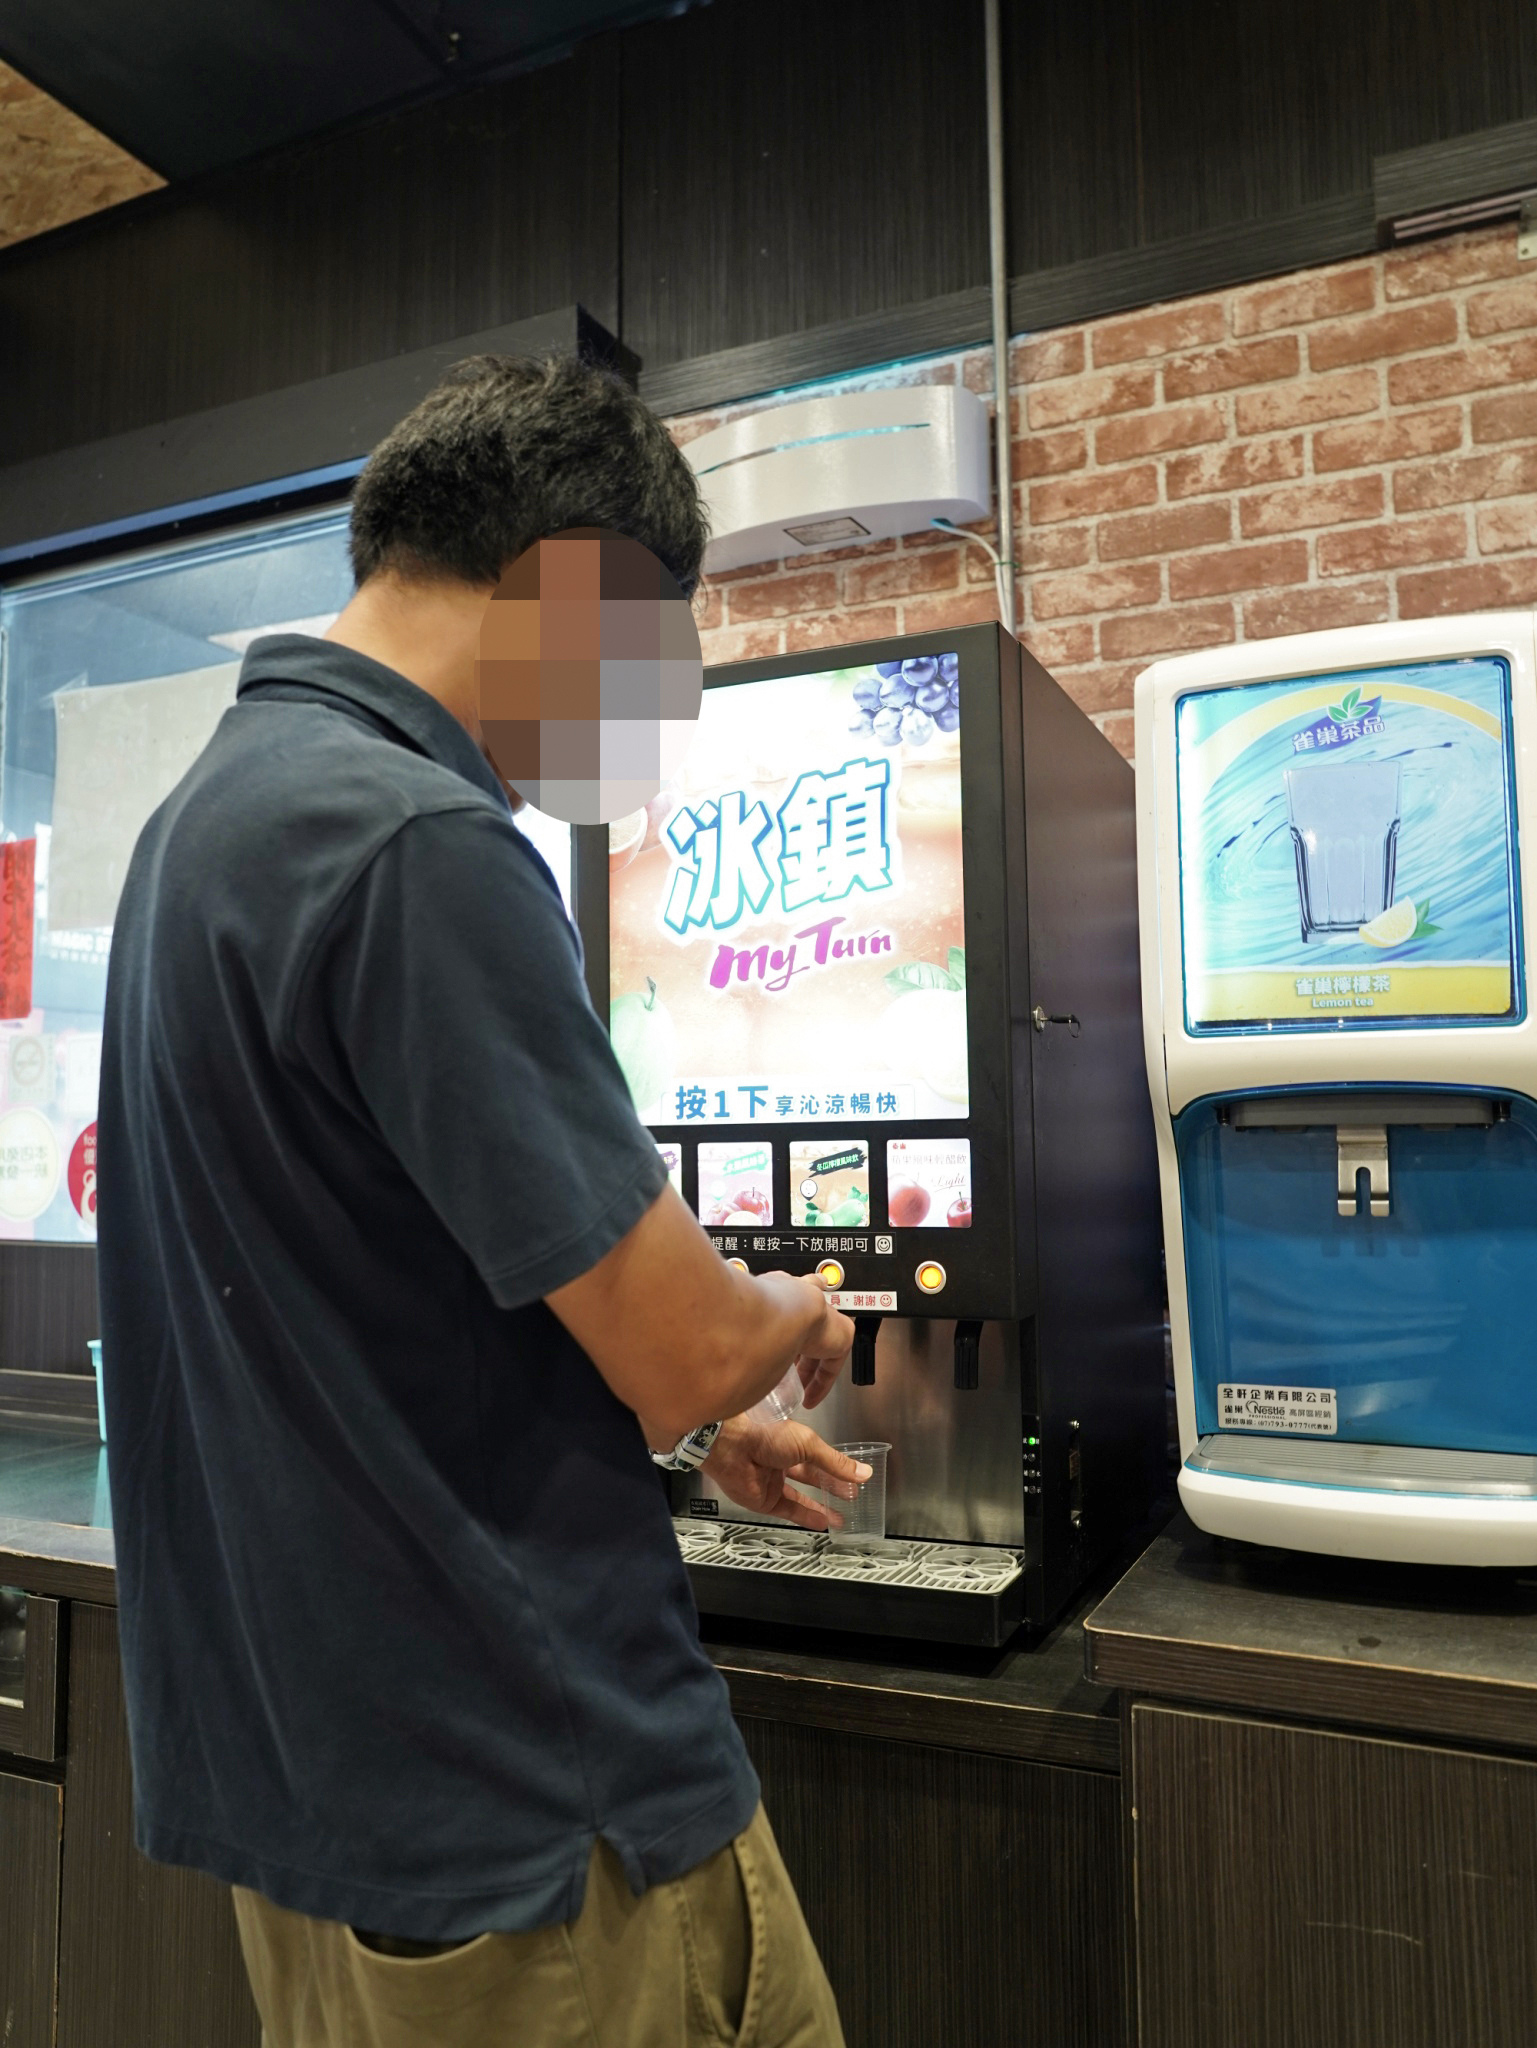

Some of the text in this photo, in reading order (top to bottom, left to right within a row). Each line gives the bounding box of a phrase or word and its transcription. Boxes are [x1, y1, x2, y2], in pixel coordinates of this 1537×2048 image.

[1293, 715, 1385, 752] 雀巢茶品
[664, 757, 893, 935] 冰鎮
[794, 916, 891, 965] Turn
[1295, 974, 1390, 995] 雀巢檸檬茶
[1312, 996, 1374, 1008] Lemon tea
[1223, 1388, 1331, 1403] 全軒企業有限公司
